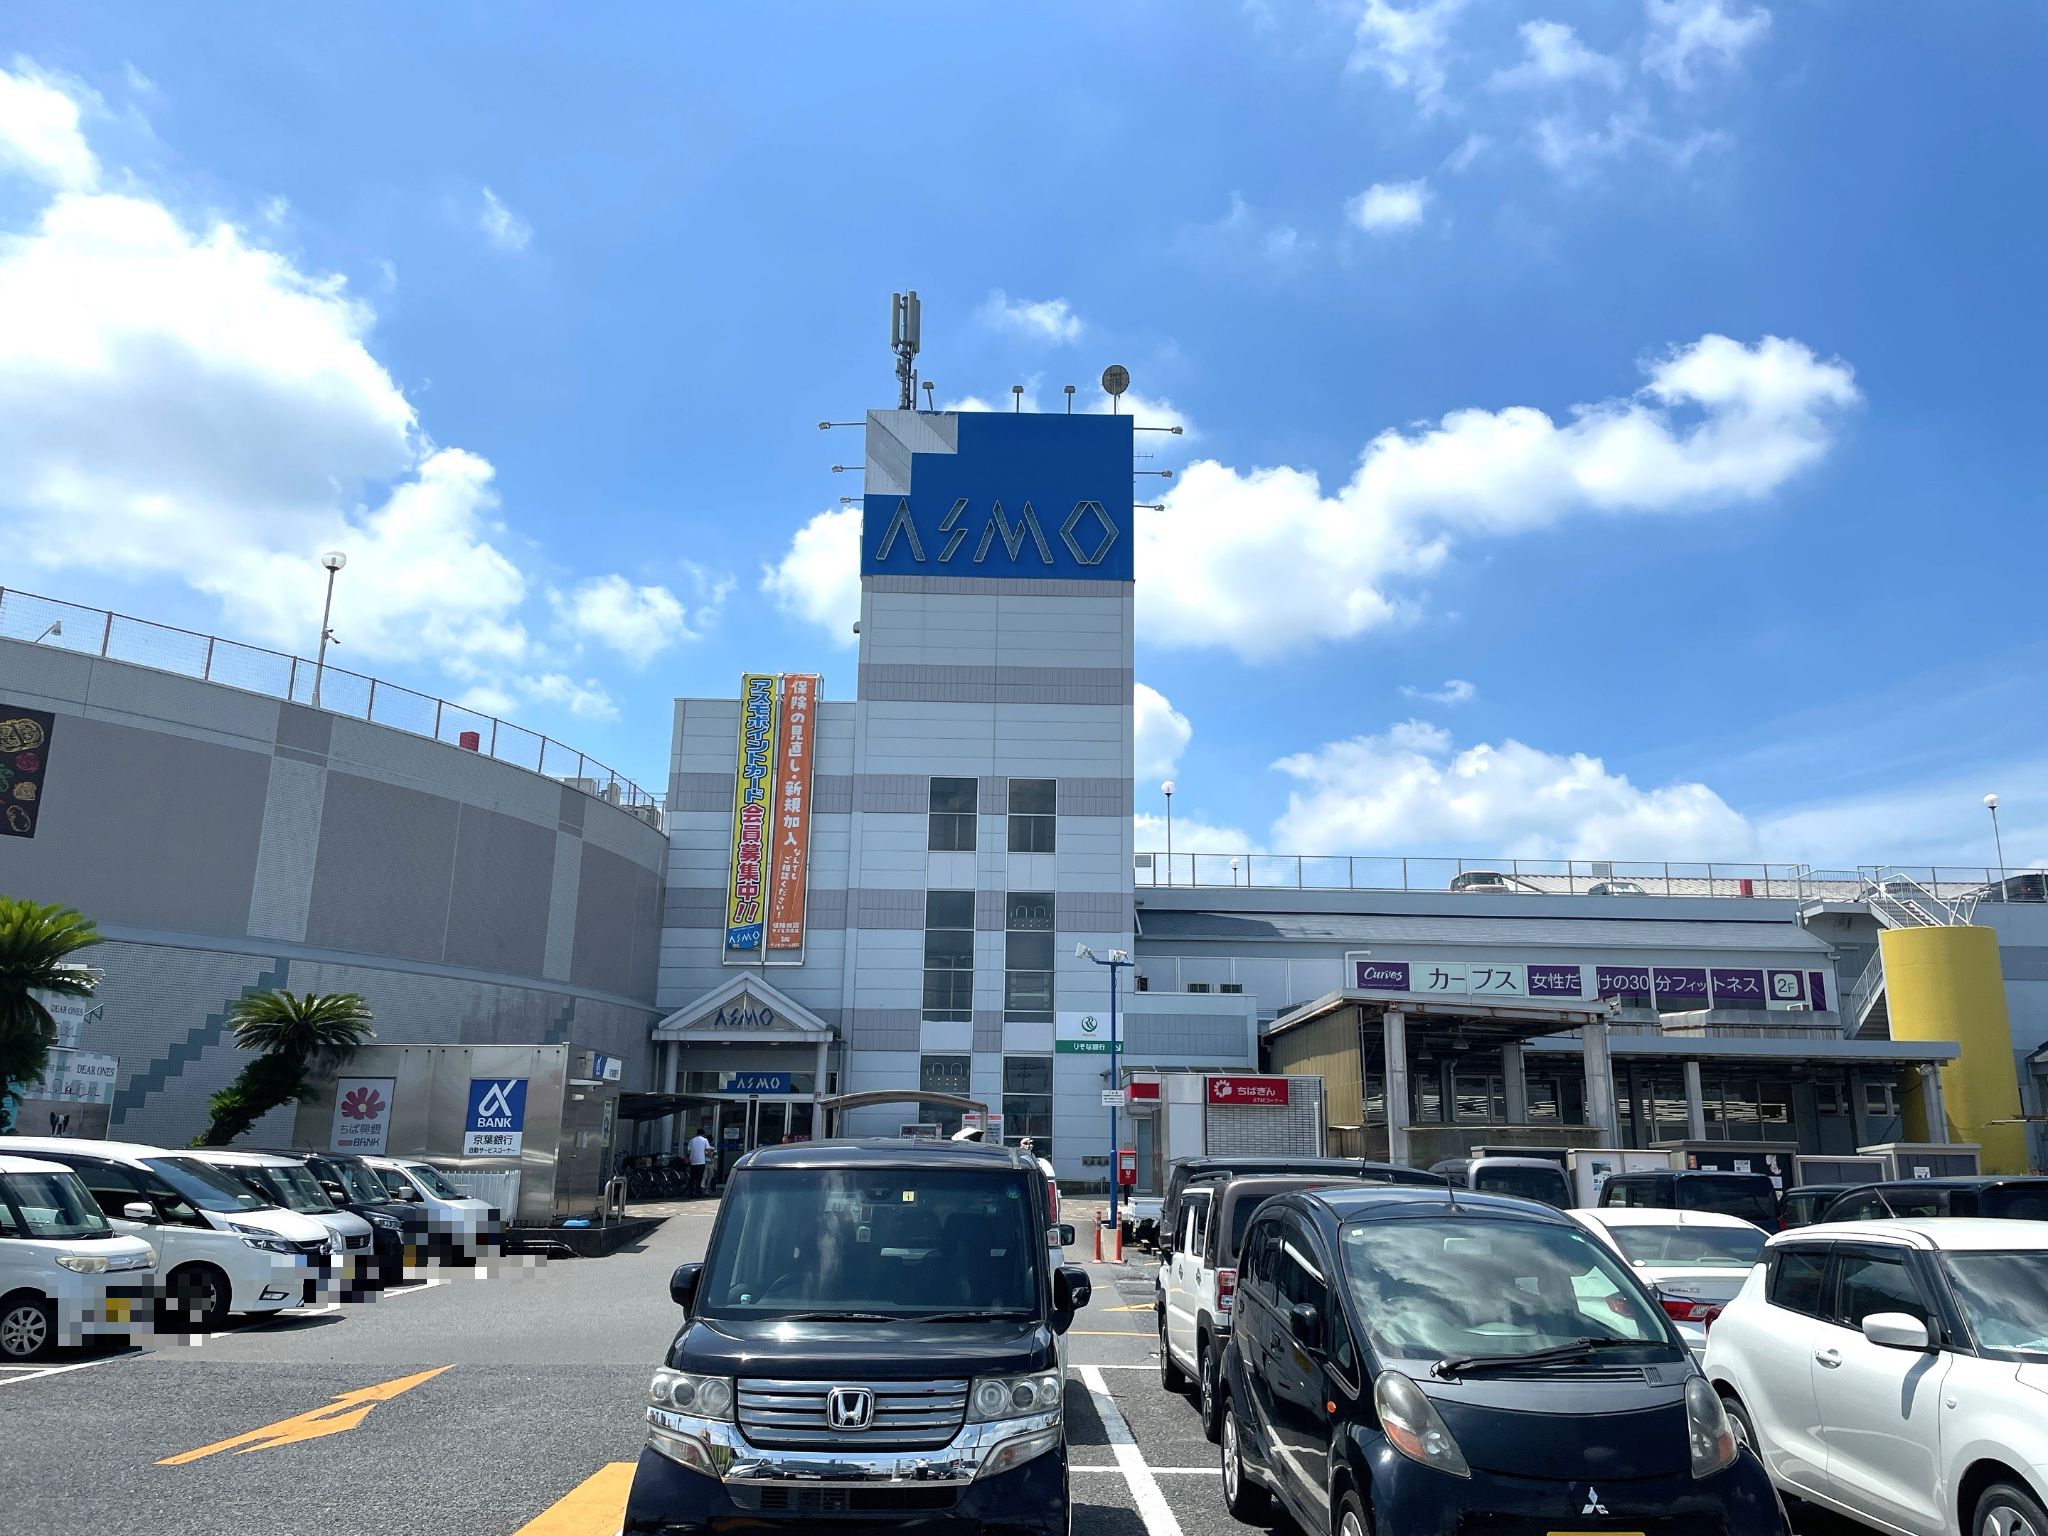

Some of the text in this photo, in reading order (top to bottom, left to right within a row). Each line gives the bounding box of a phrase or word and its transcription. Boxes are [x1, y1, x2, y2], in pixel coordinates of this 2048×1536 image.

[876, 498, 1119, 564] ASMO
[729, 931, 760, 943] ASMO
[1364, 967, 1403, 981] Curves
[1429, 968, 1517, 989] カーブス
[1778, 978, 1795, 993] 2F
[51, 1004, 66, 1013] DEAR
[68, 1006, 83, 1016] ONES
[714, 1007, 775, 1026] ASMO
[1073, 1043, 1106, 1051] りそな銀行
[77, 1064, 96, 1075] DEAR
[97, 1067, 115, 1077] ONES
[736, 1077, 780, 1089] ASMO
[1236, 1086, 1276, 1096] ちばぎん
[477, 1117, 512, 1128] BANK
[340, 1124, 382, 1135] ちば興銀
[353, 1137, 380, 1147] BANK
[473, 1134, 514, 1146] 京葉銀行
